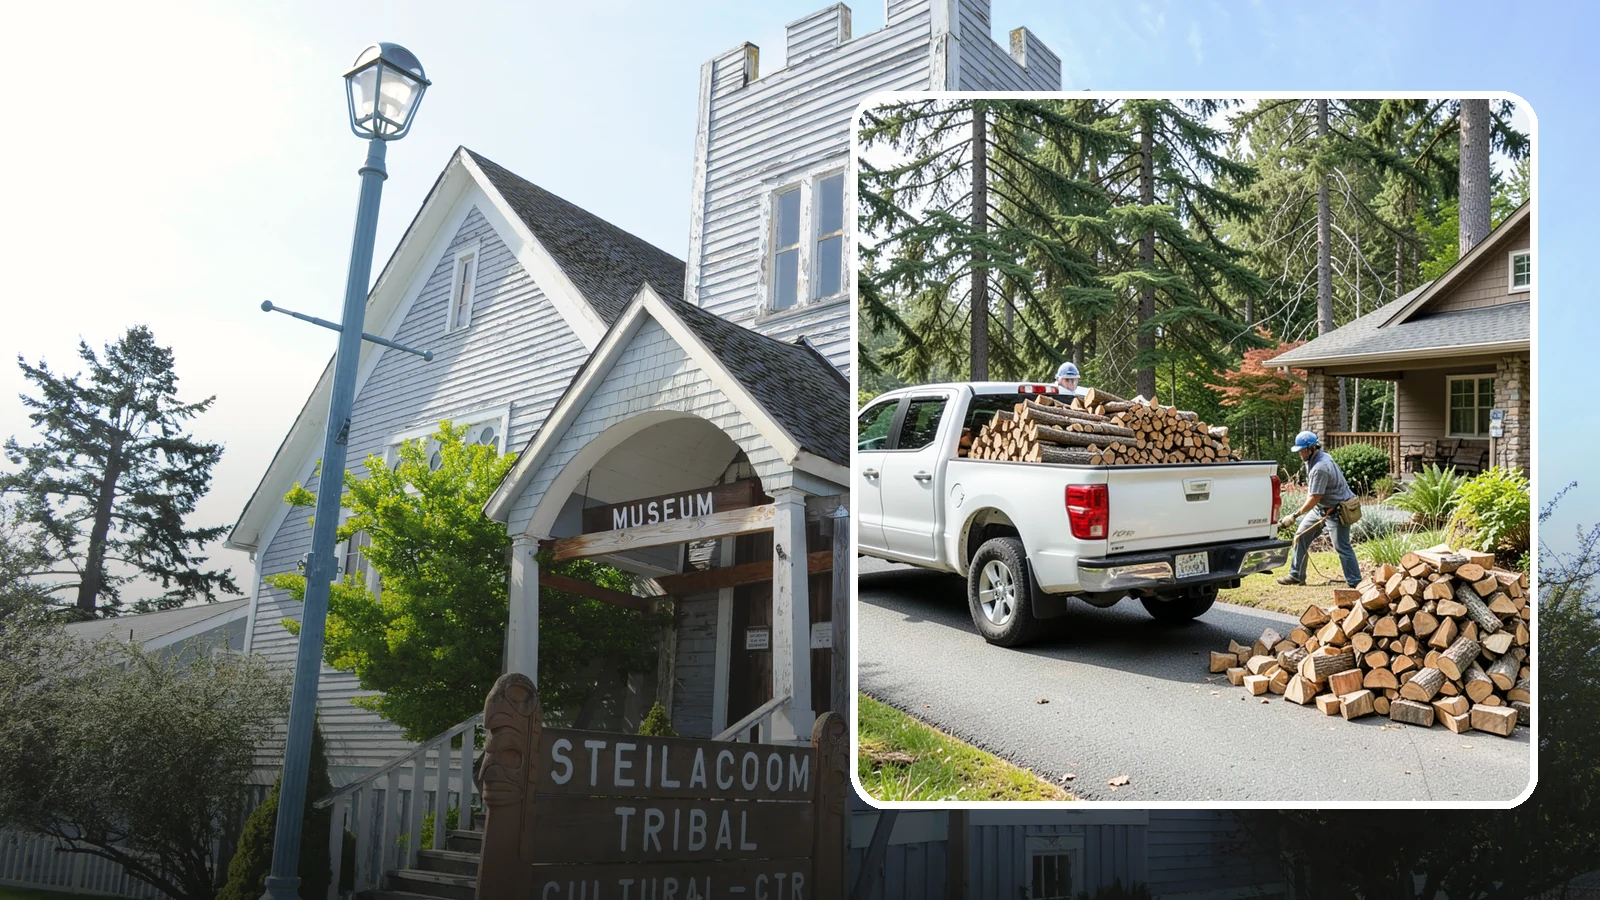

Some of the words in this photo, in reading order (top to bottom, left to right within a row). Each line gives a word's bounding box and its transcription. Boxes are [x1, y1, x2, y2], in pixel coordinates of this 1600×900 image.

[613, 491, 713, 530] MUSEUM
[550, 738, 810, 792] STEILACOOM
[615, 806, 758, 852] TRIBAL
